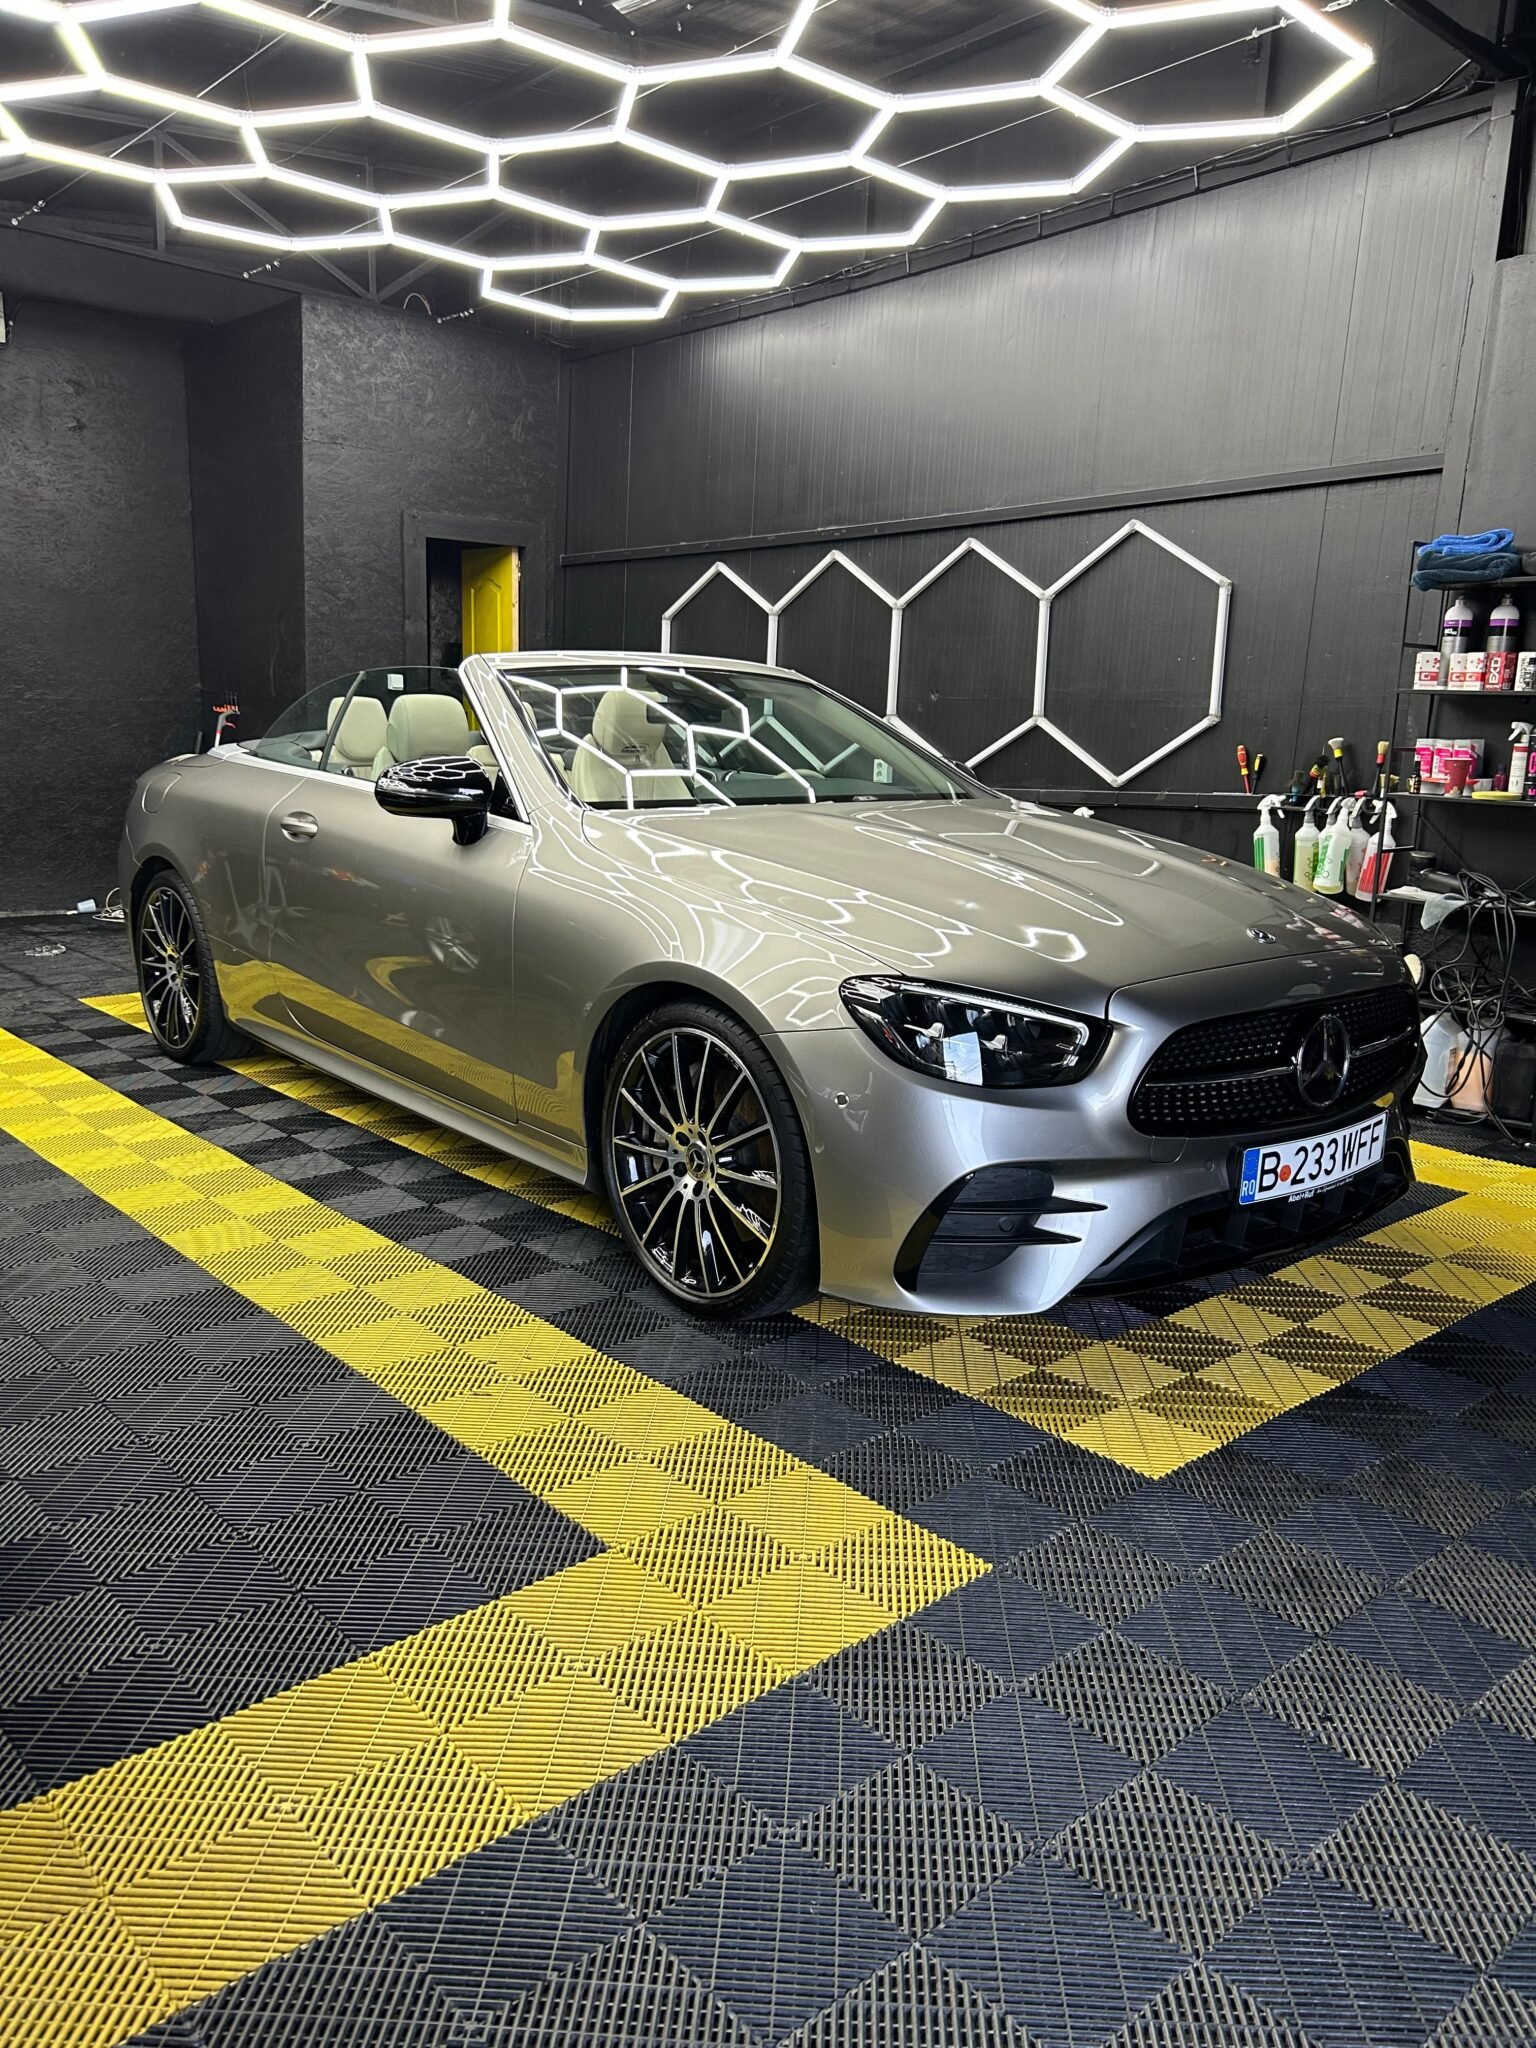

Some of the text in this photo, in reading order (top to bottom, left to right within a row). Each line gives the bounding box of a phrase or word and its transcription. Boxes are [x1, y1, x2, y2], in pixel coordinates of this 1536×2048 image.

[1258, 1118, 1384, 1193] B 233 WFF
[1241, 1180, 1256, 1197] RO
